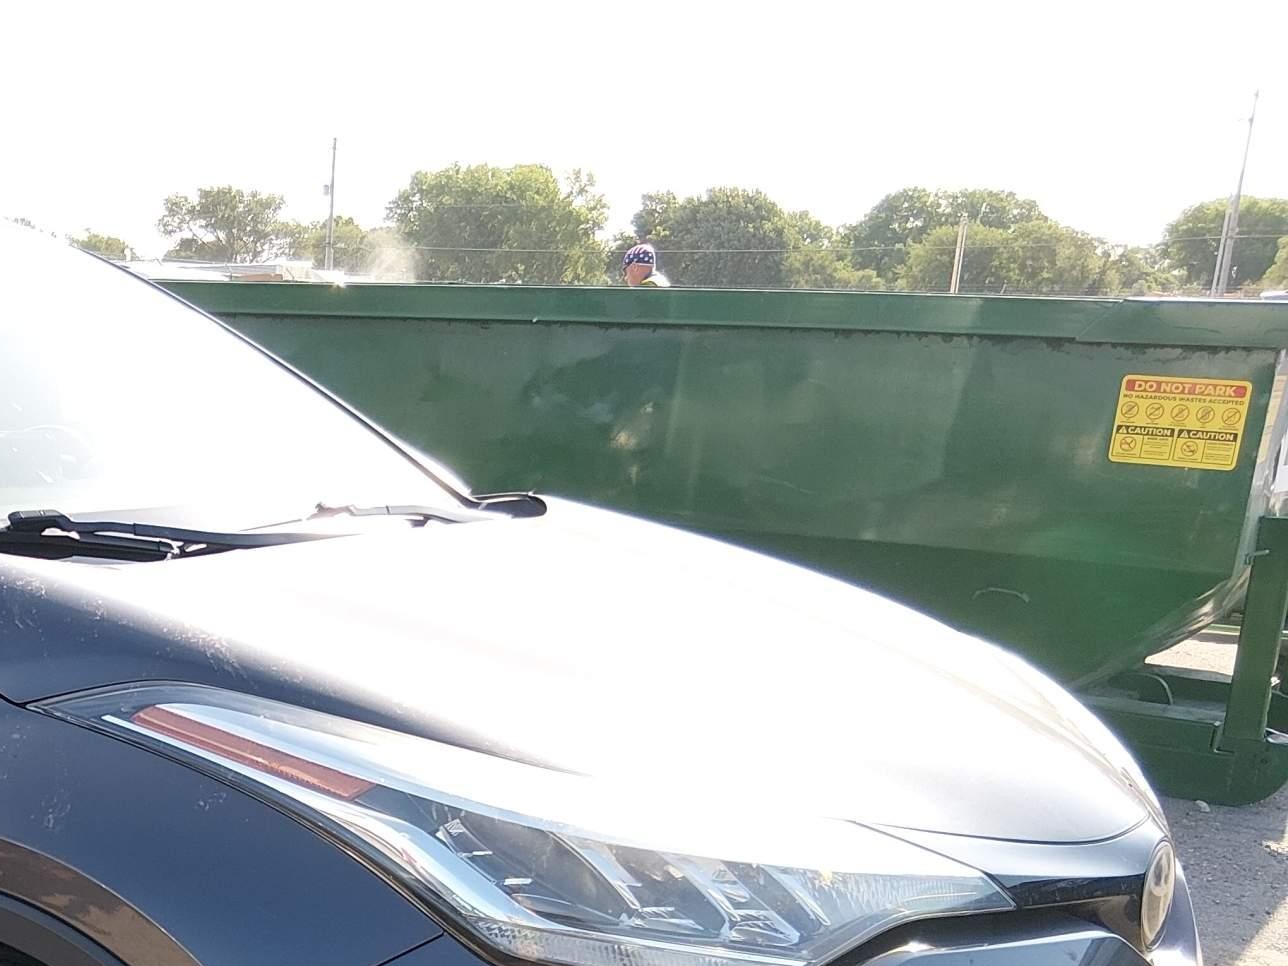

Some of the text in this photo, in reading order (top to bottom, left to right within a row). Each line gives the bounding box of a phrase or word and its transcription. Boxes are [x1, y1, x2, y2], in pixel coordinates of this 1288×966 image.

[1134, 381, 1236, 397] DO NOT PARK
[1128, 427, 1172, 436] CAUTION
[1189, 431, 1234, 441] CAUTION
